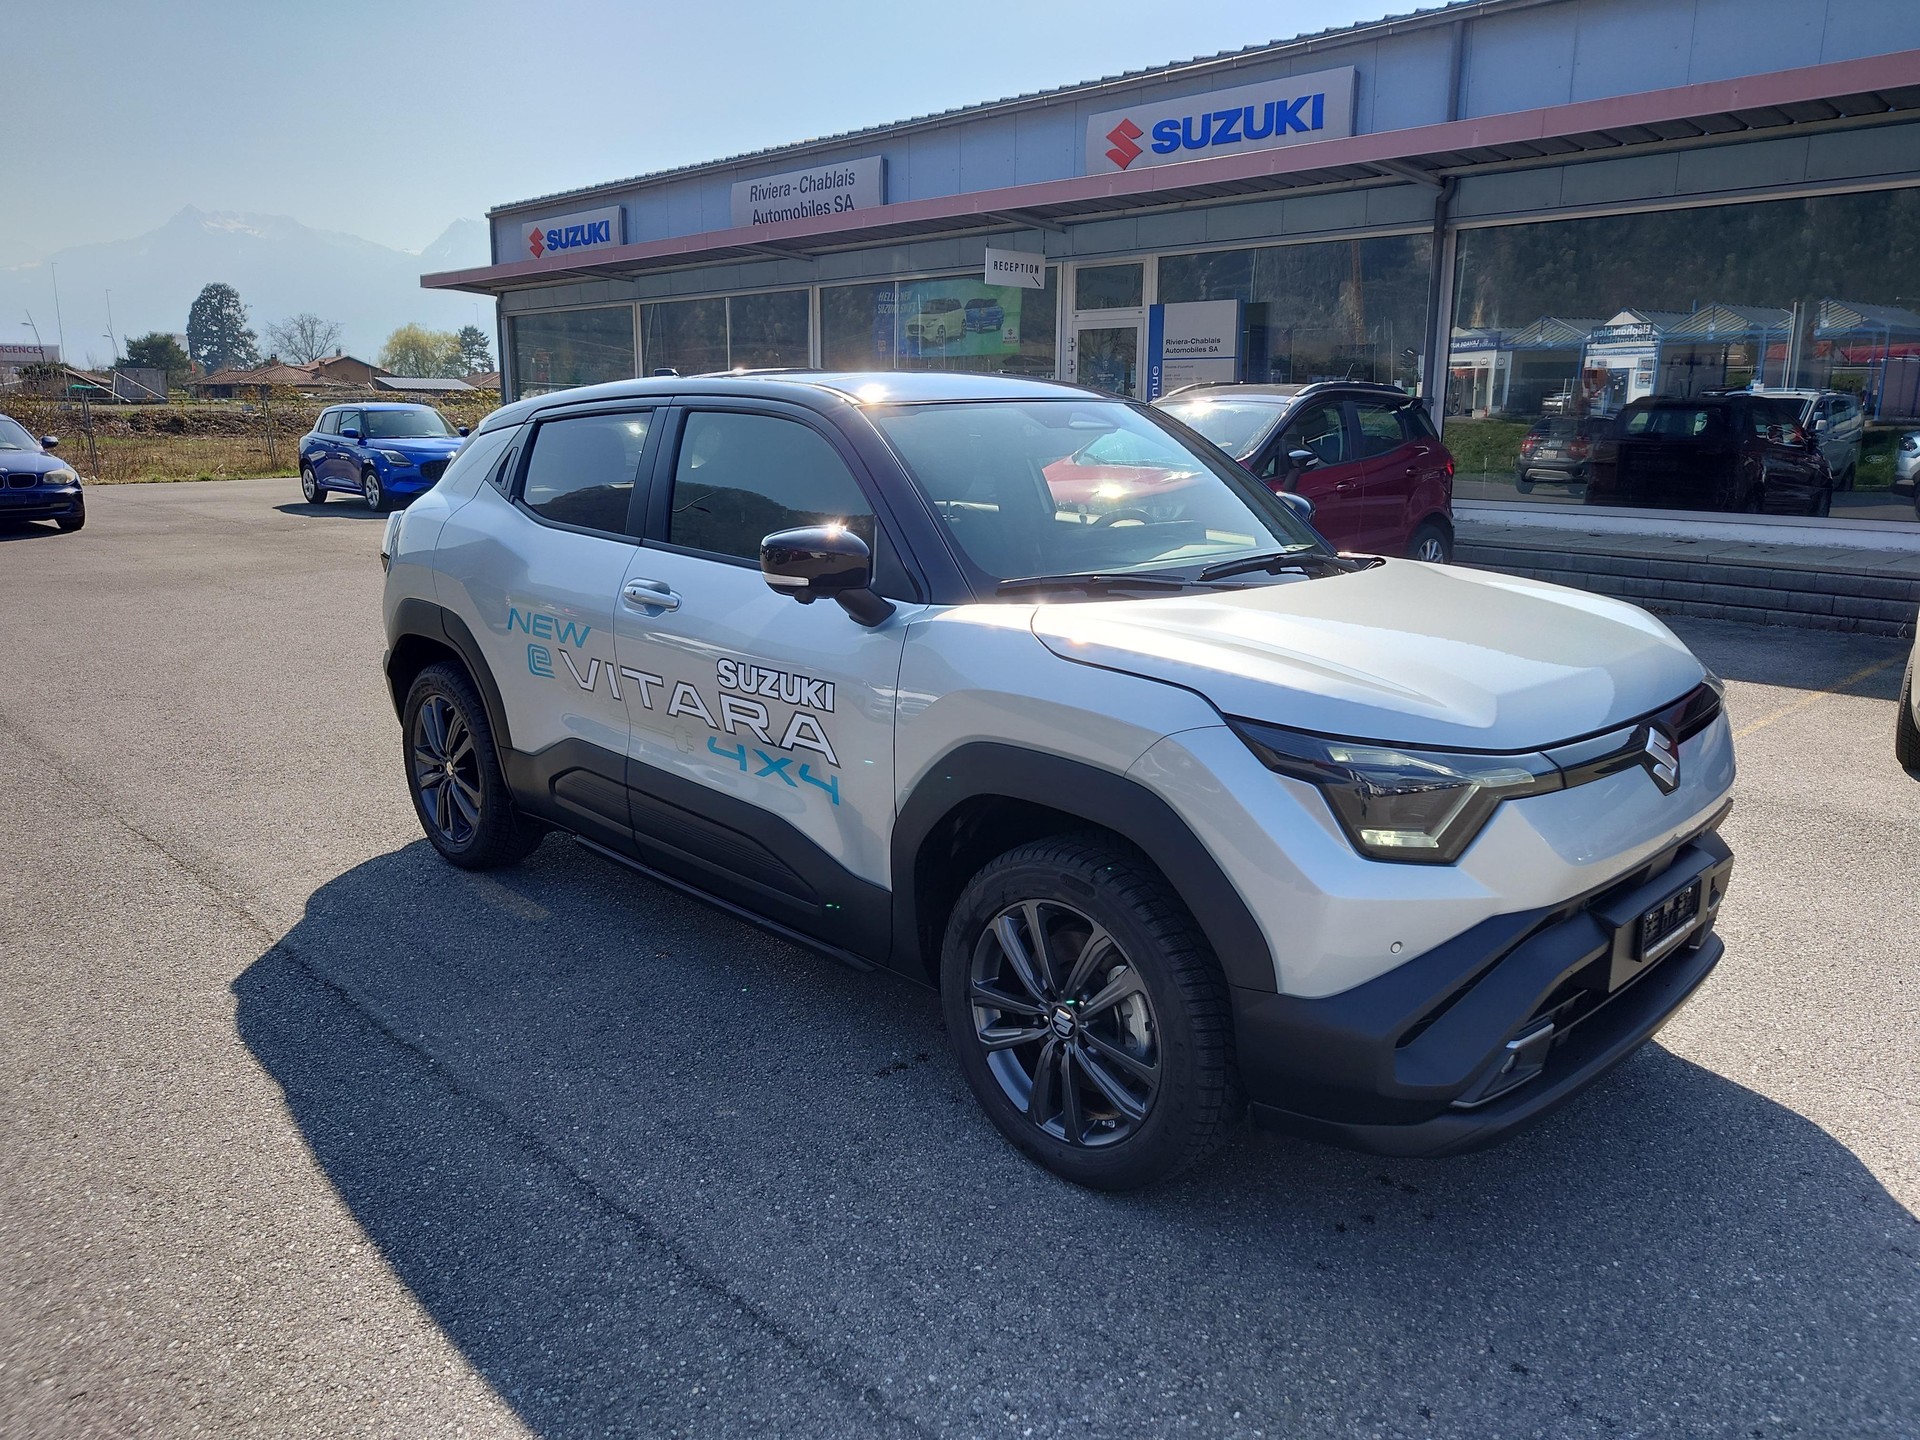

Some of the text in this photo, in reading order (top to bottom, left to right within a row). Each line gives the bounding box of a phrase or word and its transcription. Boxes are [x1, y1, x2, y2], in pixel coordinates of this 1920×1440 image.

[1151, 93, 1325, 155] SUZUKI
[750, 182, 790, 202] Riviera
[799, 168, 855, 194] Chablais
[752, 194, 855, 225] Automobiles SA
[546, 220, 610, 251] SUZUKI
[993, 260, 1039, 275] RECEPTION
[1165, 337, 1221, 346] Riviera-Chablais
[507, 607, 591, 648] NEW
[716, 658, 835, 713] SUZUKI
